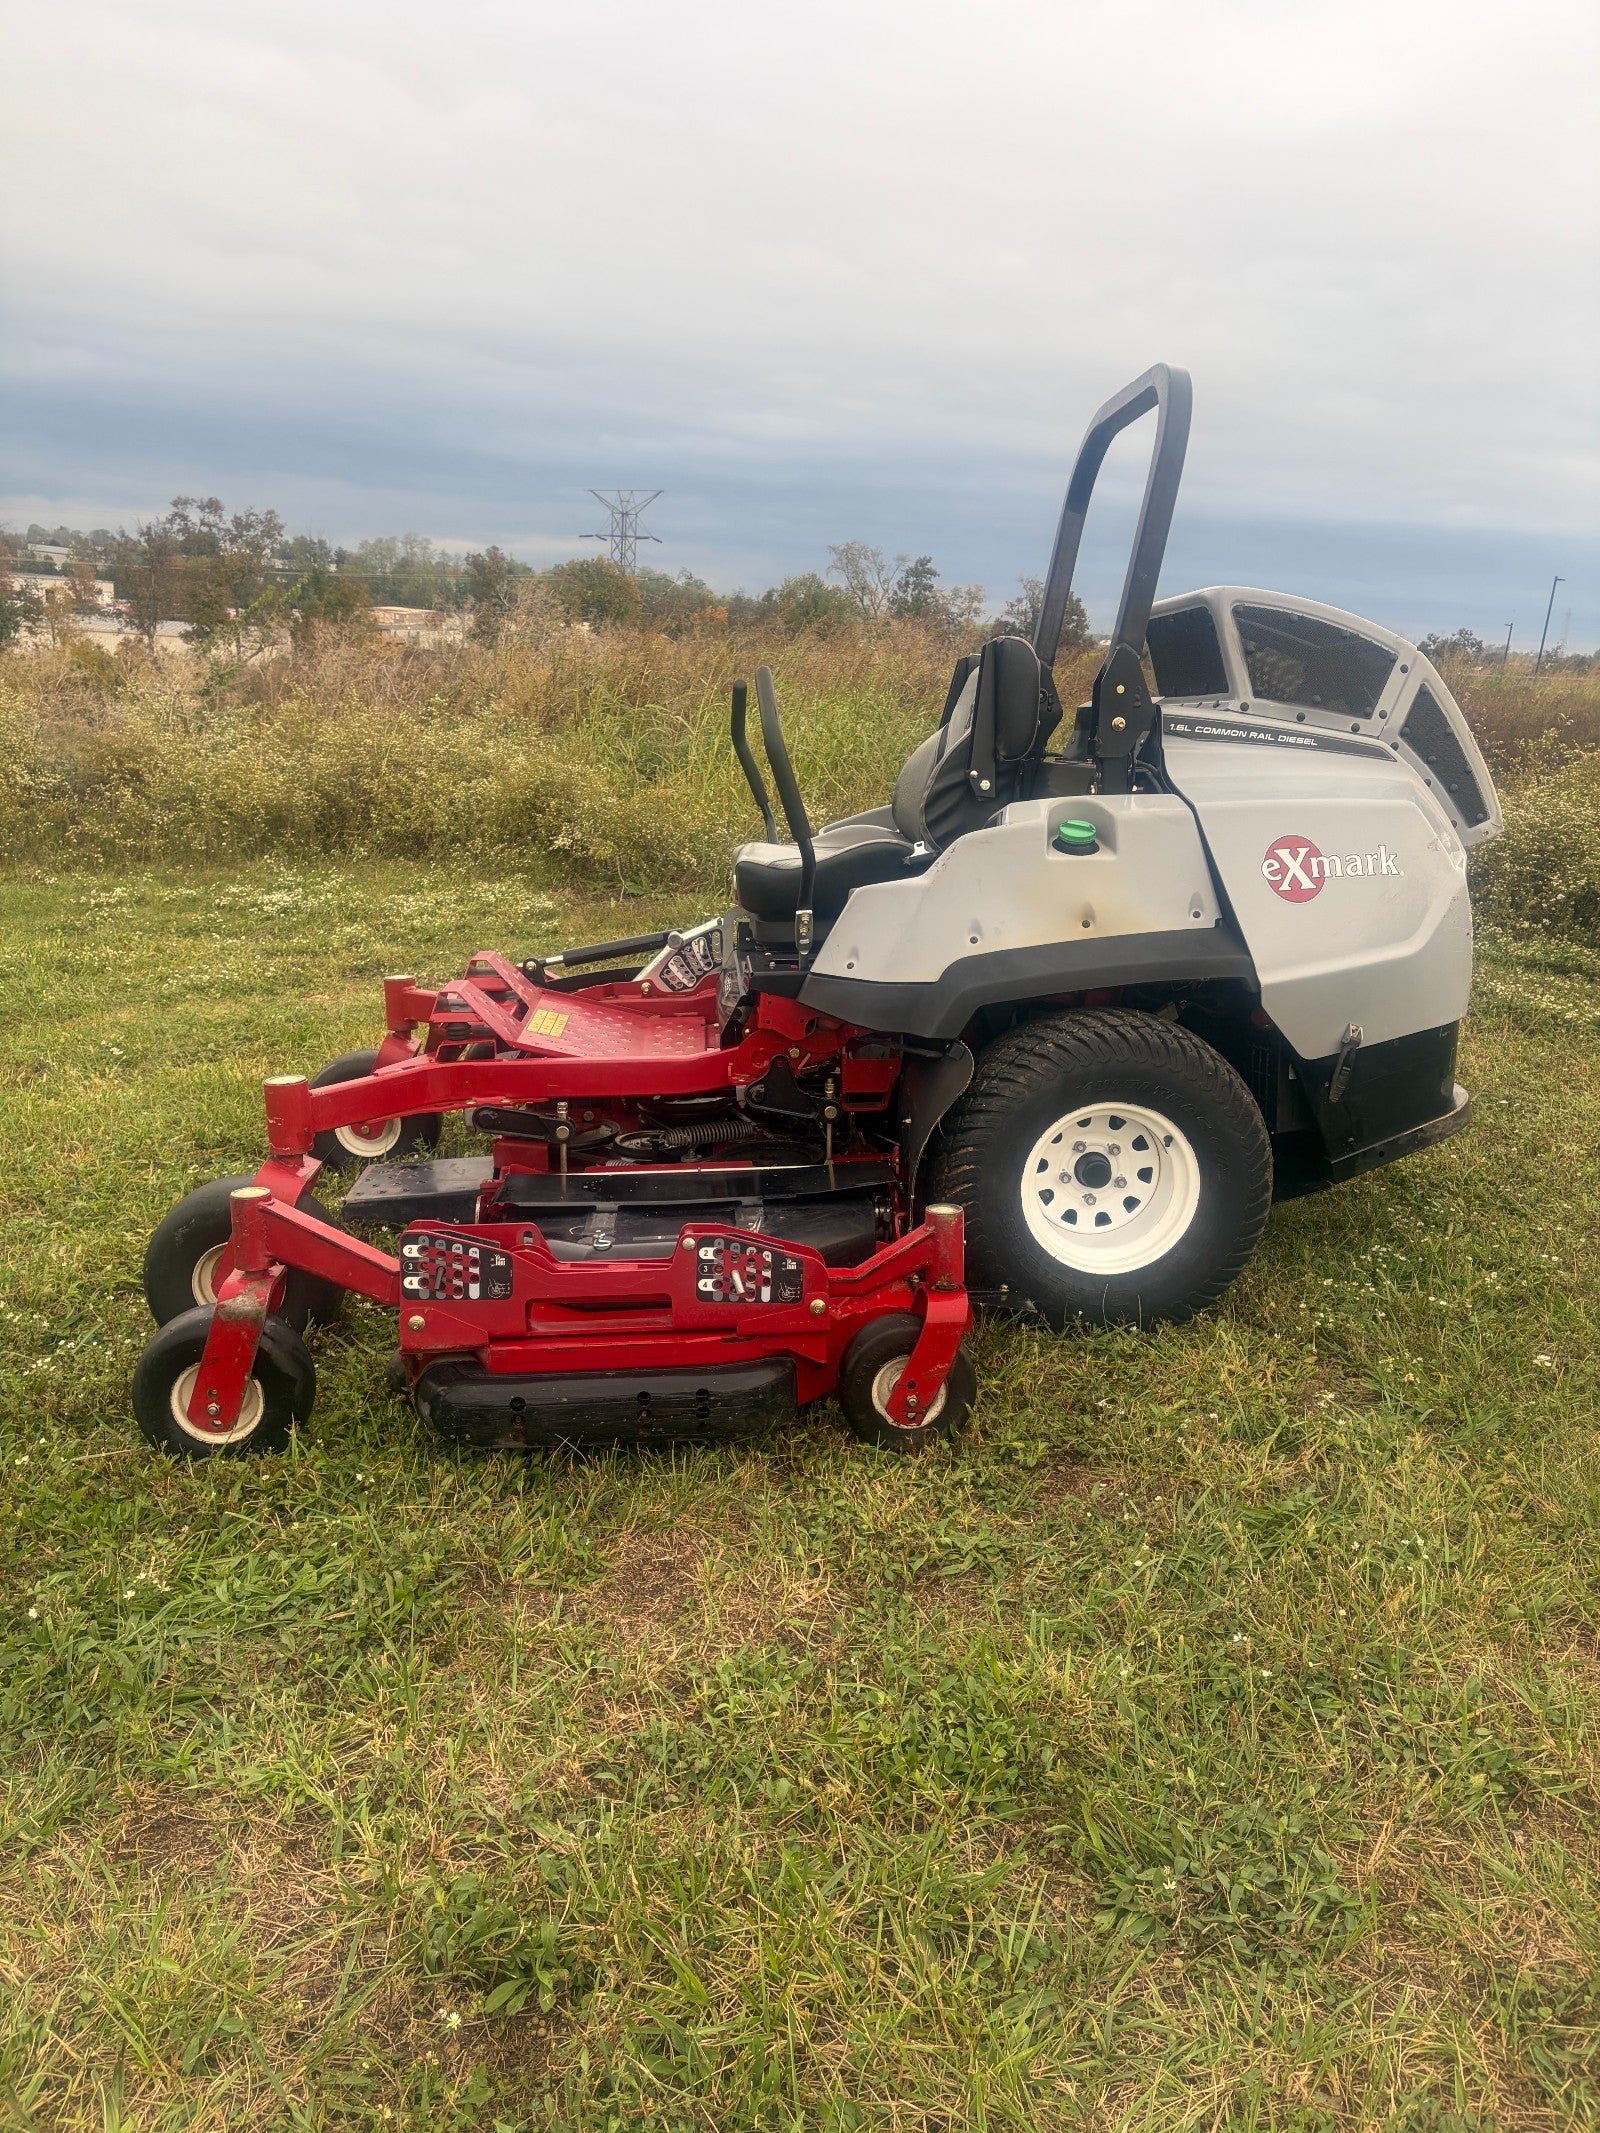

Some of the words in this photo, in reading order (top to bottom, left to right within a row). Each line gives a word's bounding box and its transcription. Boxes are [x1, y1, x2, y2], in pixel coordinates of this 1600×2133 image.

[1169, 723, 1192, 732] 1.6L
[1194, 725, 1248, 738] COMMON
[1249, 731, 1275, 741] RAIL
[1277, 735, 1318, 746] DIESEL
[1261, 845, 1402, 891] eXmark
[703, 1249, 709, 1257] 2
[408, 1262, 413, 1270] 3
[703, 1265, 708, 1273] 3
